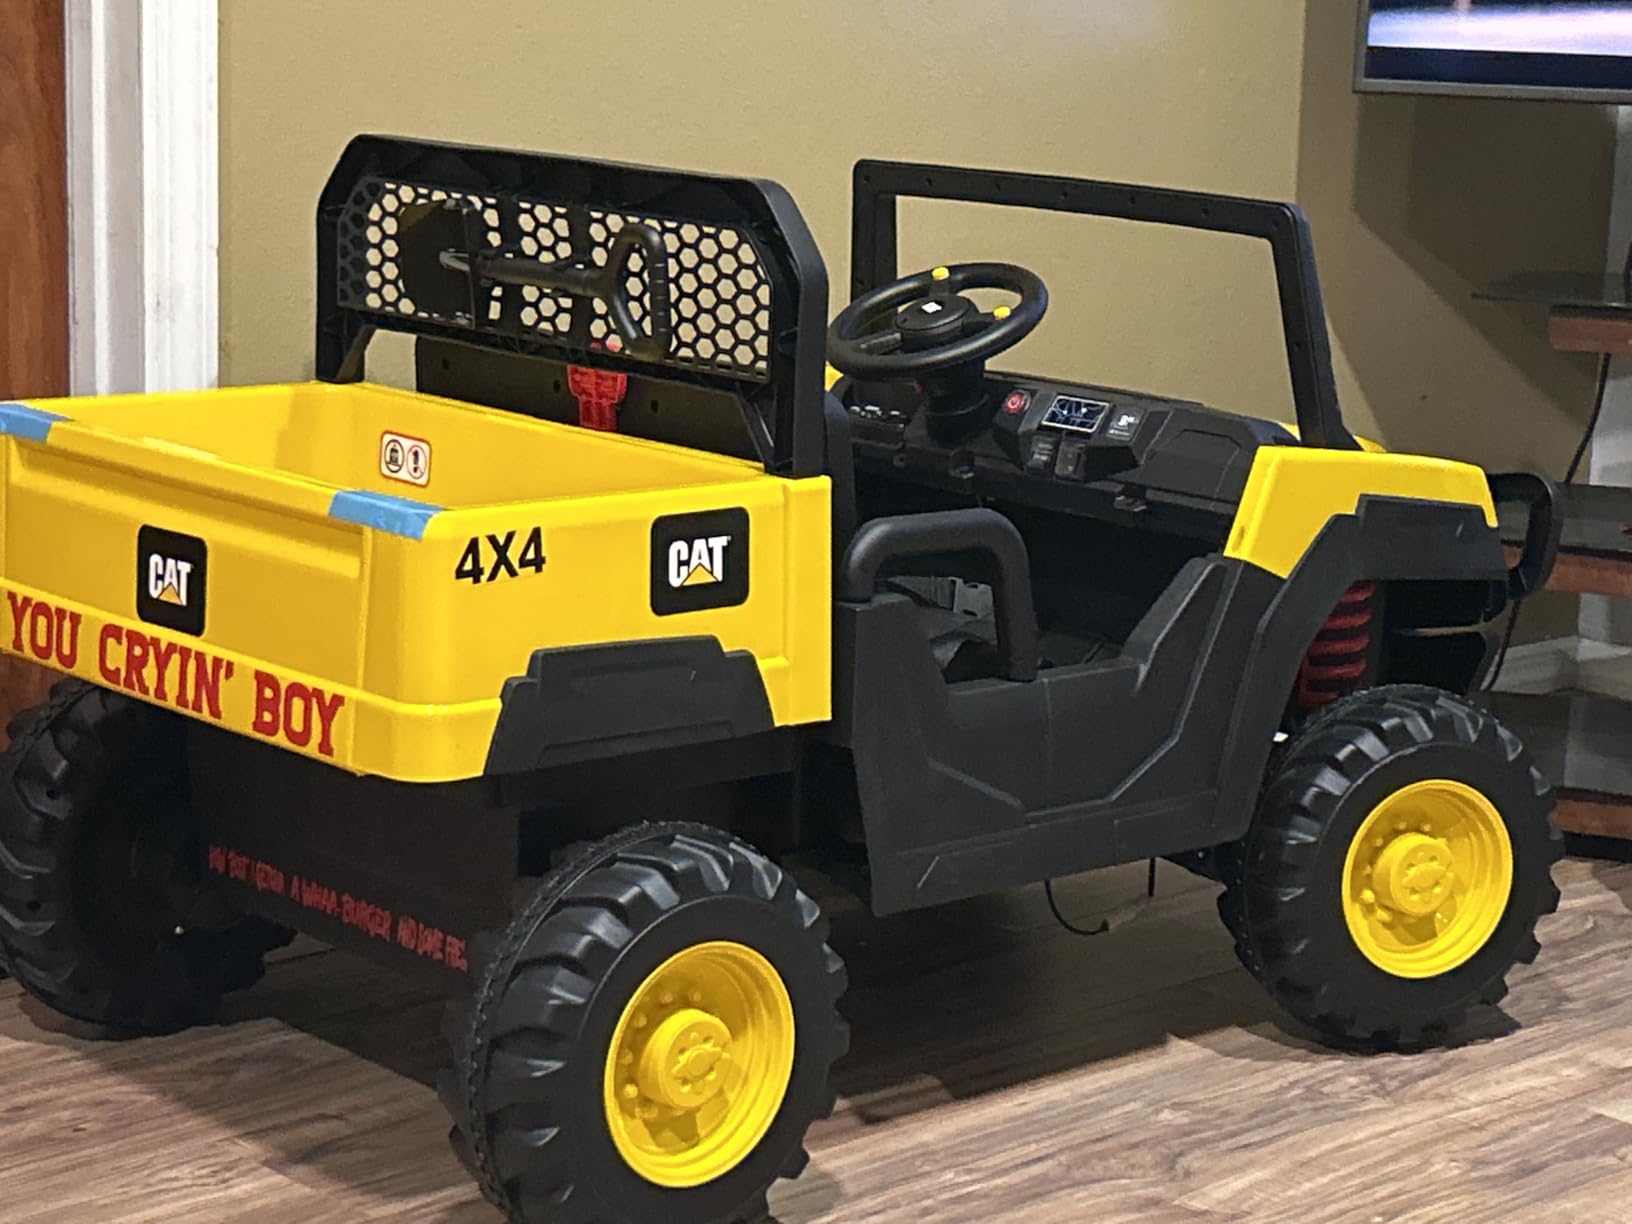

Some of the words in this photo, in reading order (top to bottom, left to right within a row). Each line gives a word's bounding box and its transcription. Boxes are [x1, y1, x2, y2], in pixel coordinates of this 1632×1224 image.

[149, 553, 192, 607] CAT
[454, 526, 546, 584] 4X4
[668, 535, 729, 588] CAT
[7, 590, 82, 669] YOU
[98, 623, 234, 719] CRYIN'
[252, 669, 345, 756] BOY
